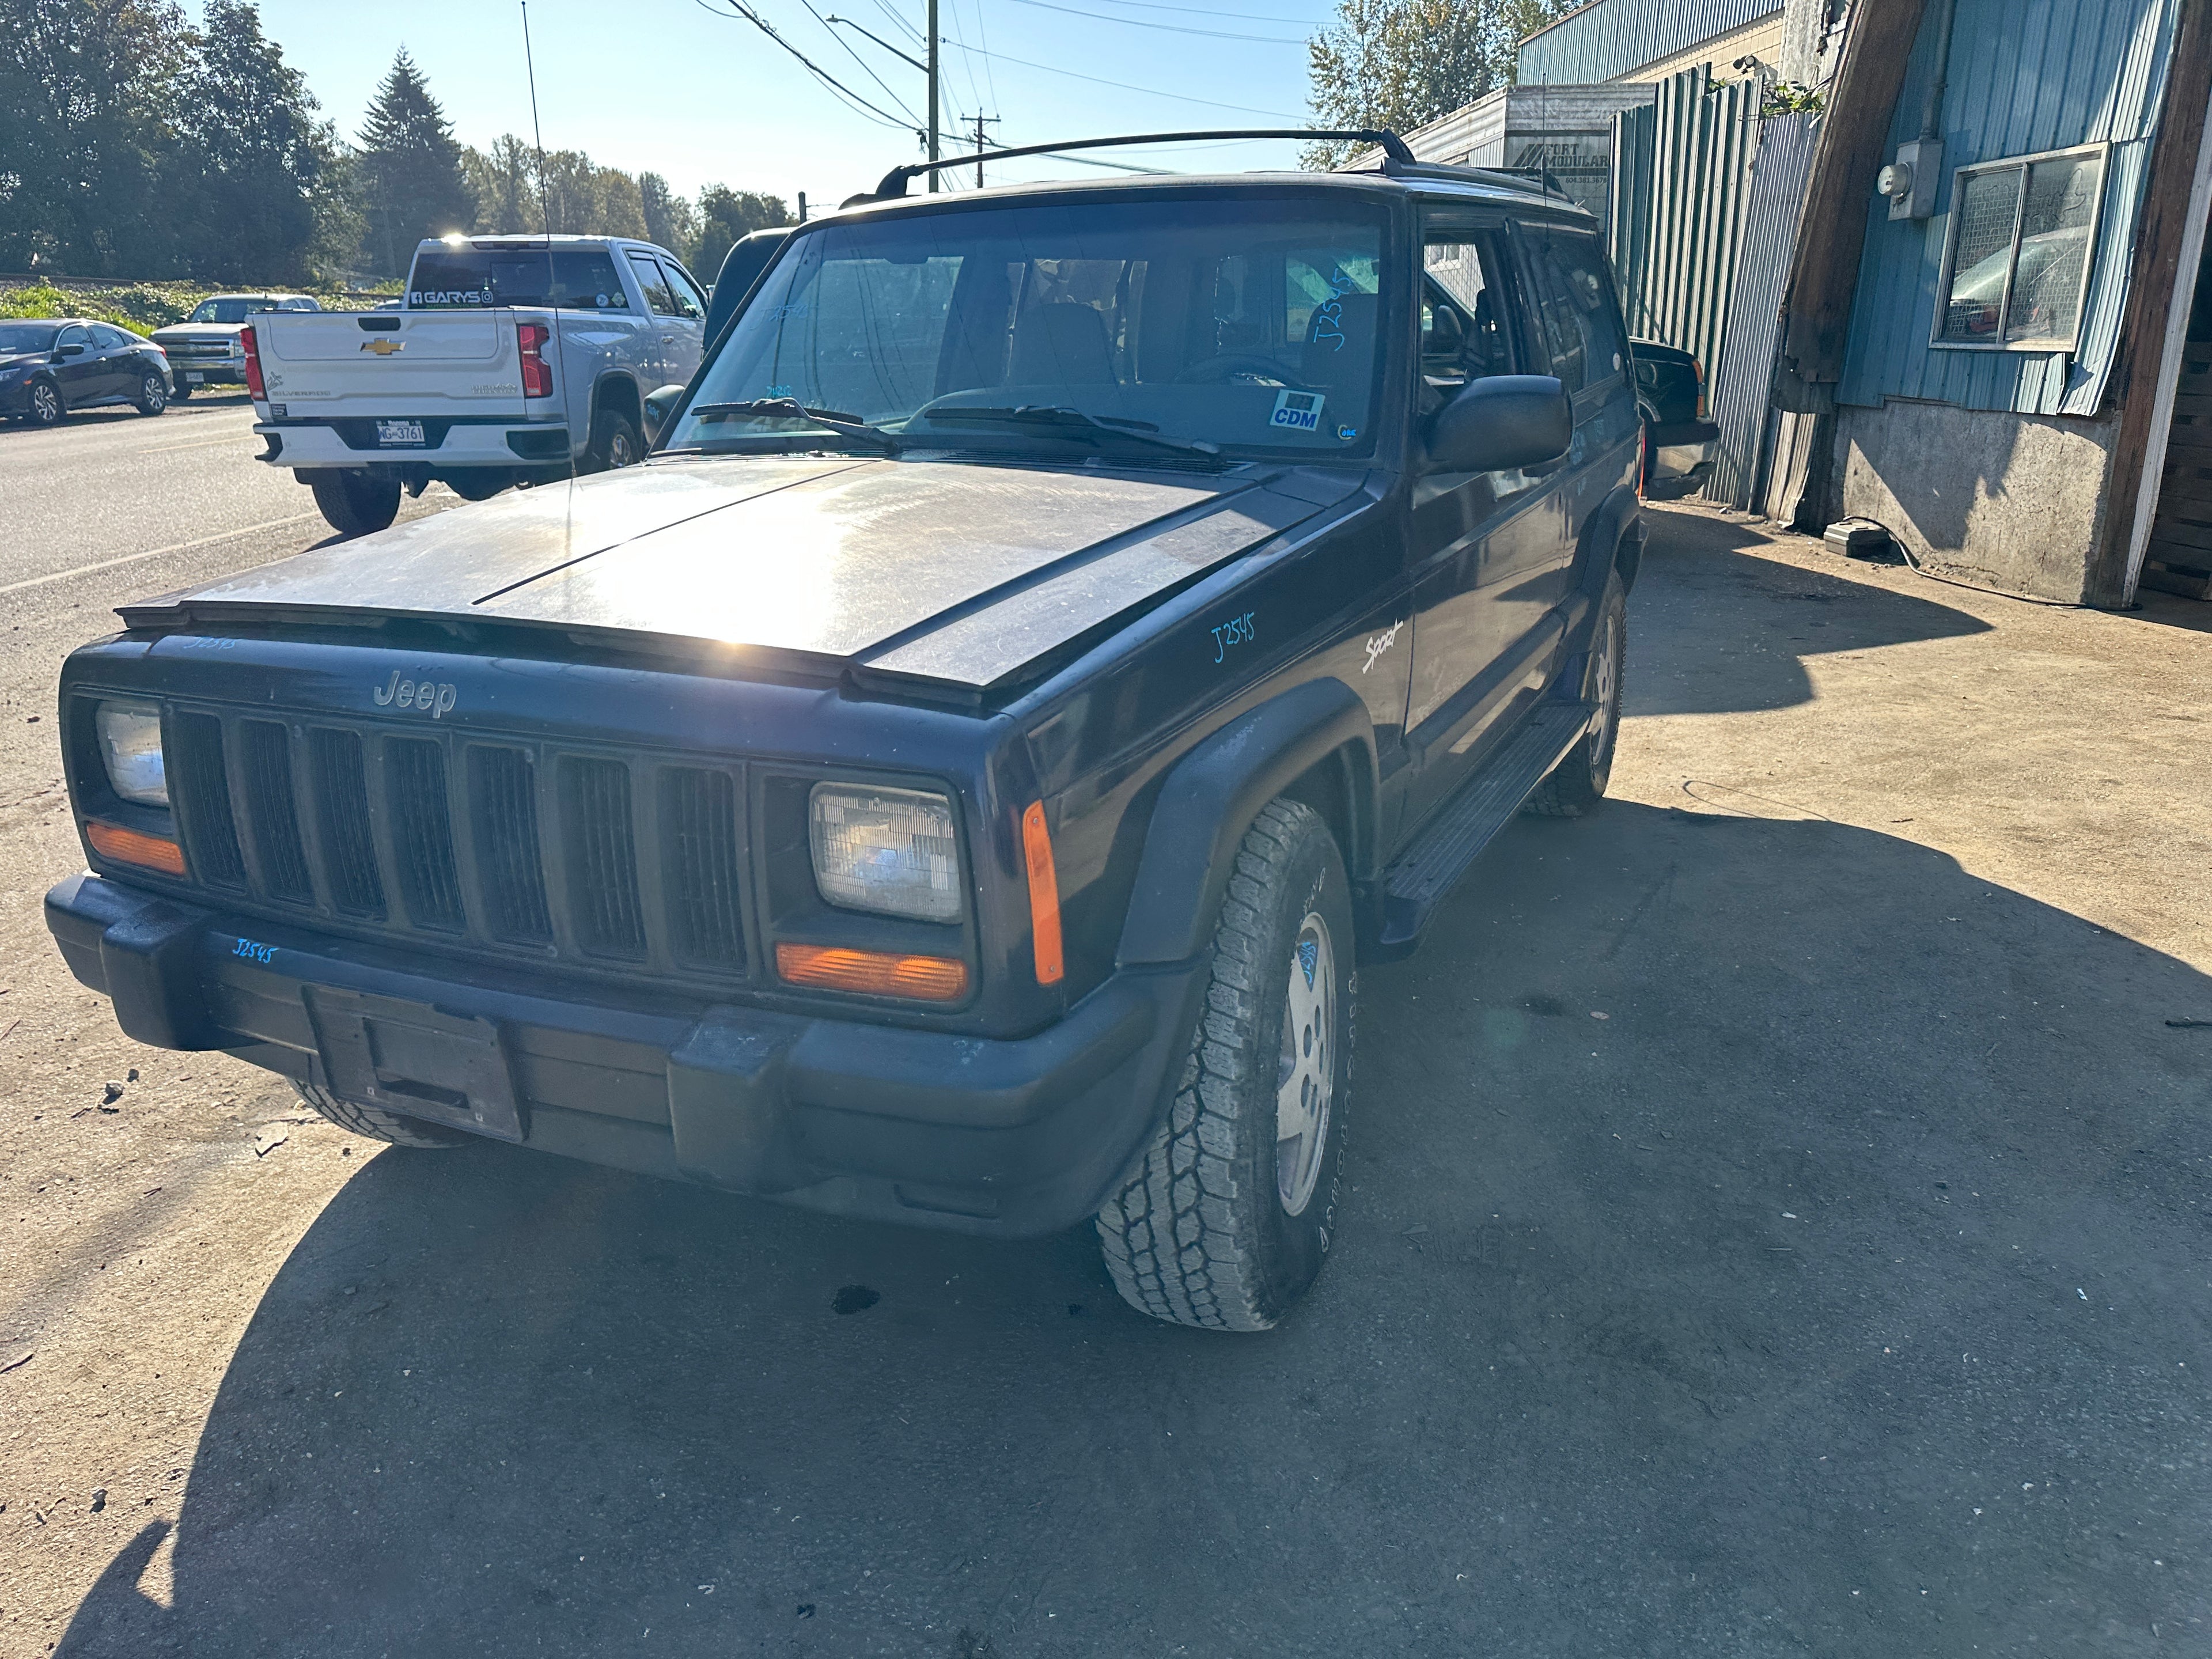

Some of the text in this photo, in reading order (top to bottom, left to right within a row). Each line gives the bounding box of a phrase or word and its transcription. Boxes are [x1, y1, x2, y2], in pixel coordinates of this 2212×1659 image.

[1544, 143, 1580, 155] FORT
[1545, 156, 1608, 167] MODULAR
[424, 291, 481, 304] GARYS
[1313, 267, 1351, 352] J2545
[1274, 408, 1317, 428] CDM
[397, 427, 422, 439] 3761
[1211, 612, 1255, 663] J2545
[373, 670, 457, 718] Jeep
[232, 938, 279, 964] J2545
